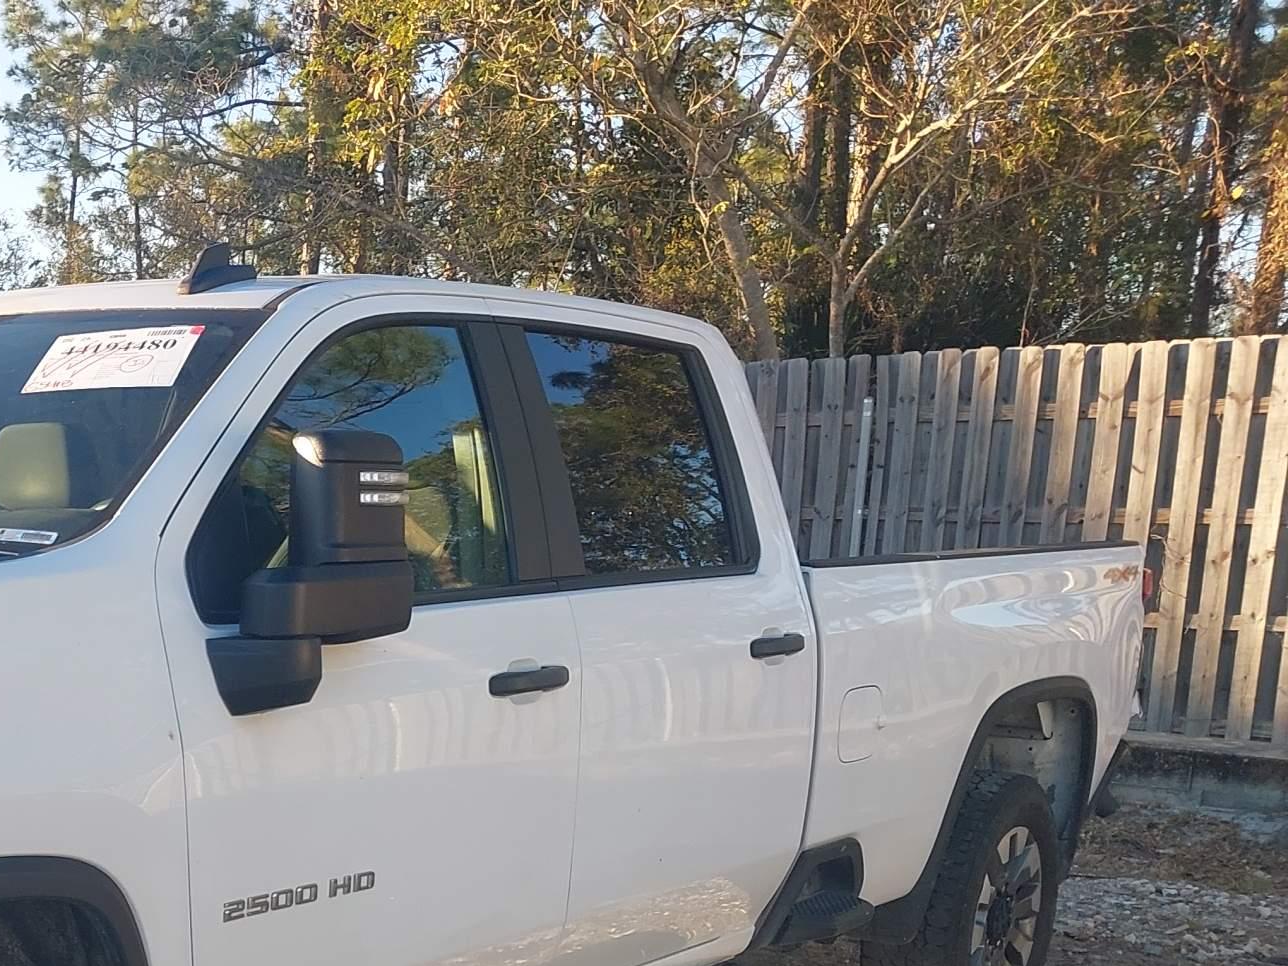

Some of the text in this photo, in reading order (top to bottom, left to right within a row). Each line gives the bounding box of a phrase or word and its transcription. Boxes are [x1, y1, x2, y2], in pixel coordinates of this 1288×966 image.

[60, 338, 178, 356] 44194480
[223, 871, 376, 923] 2500 HD
